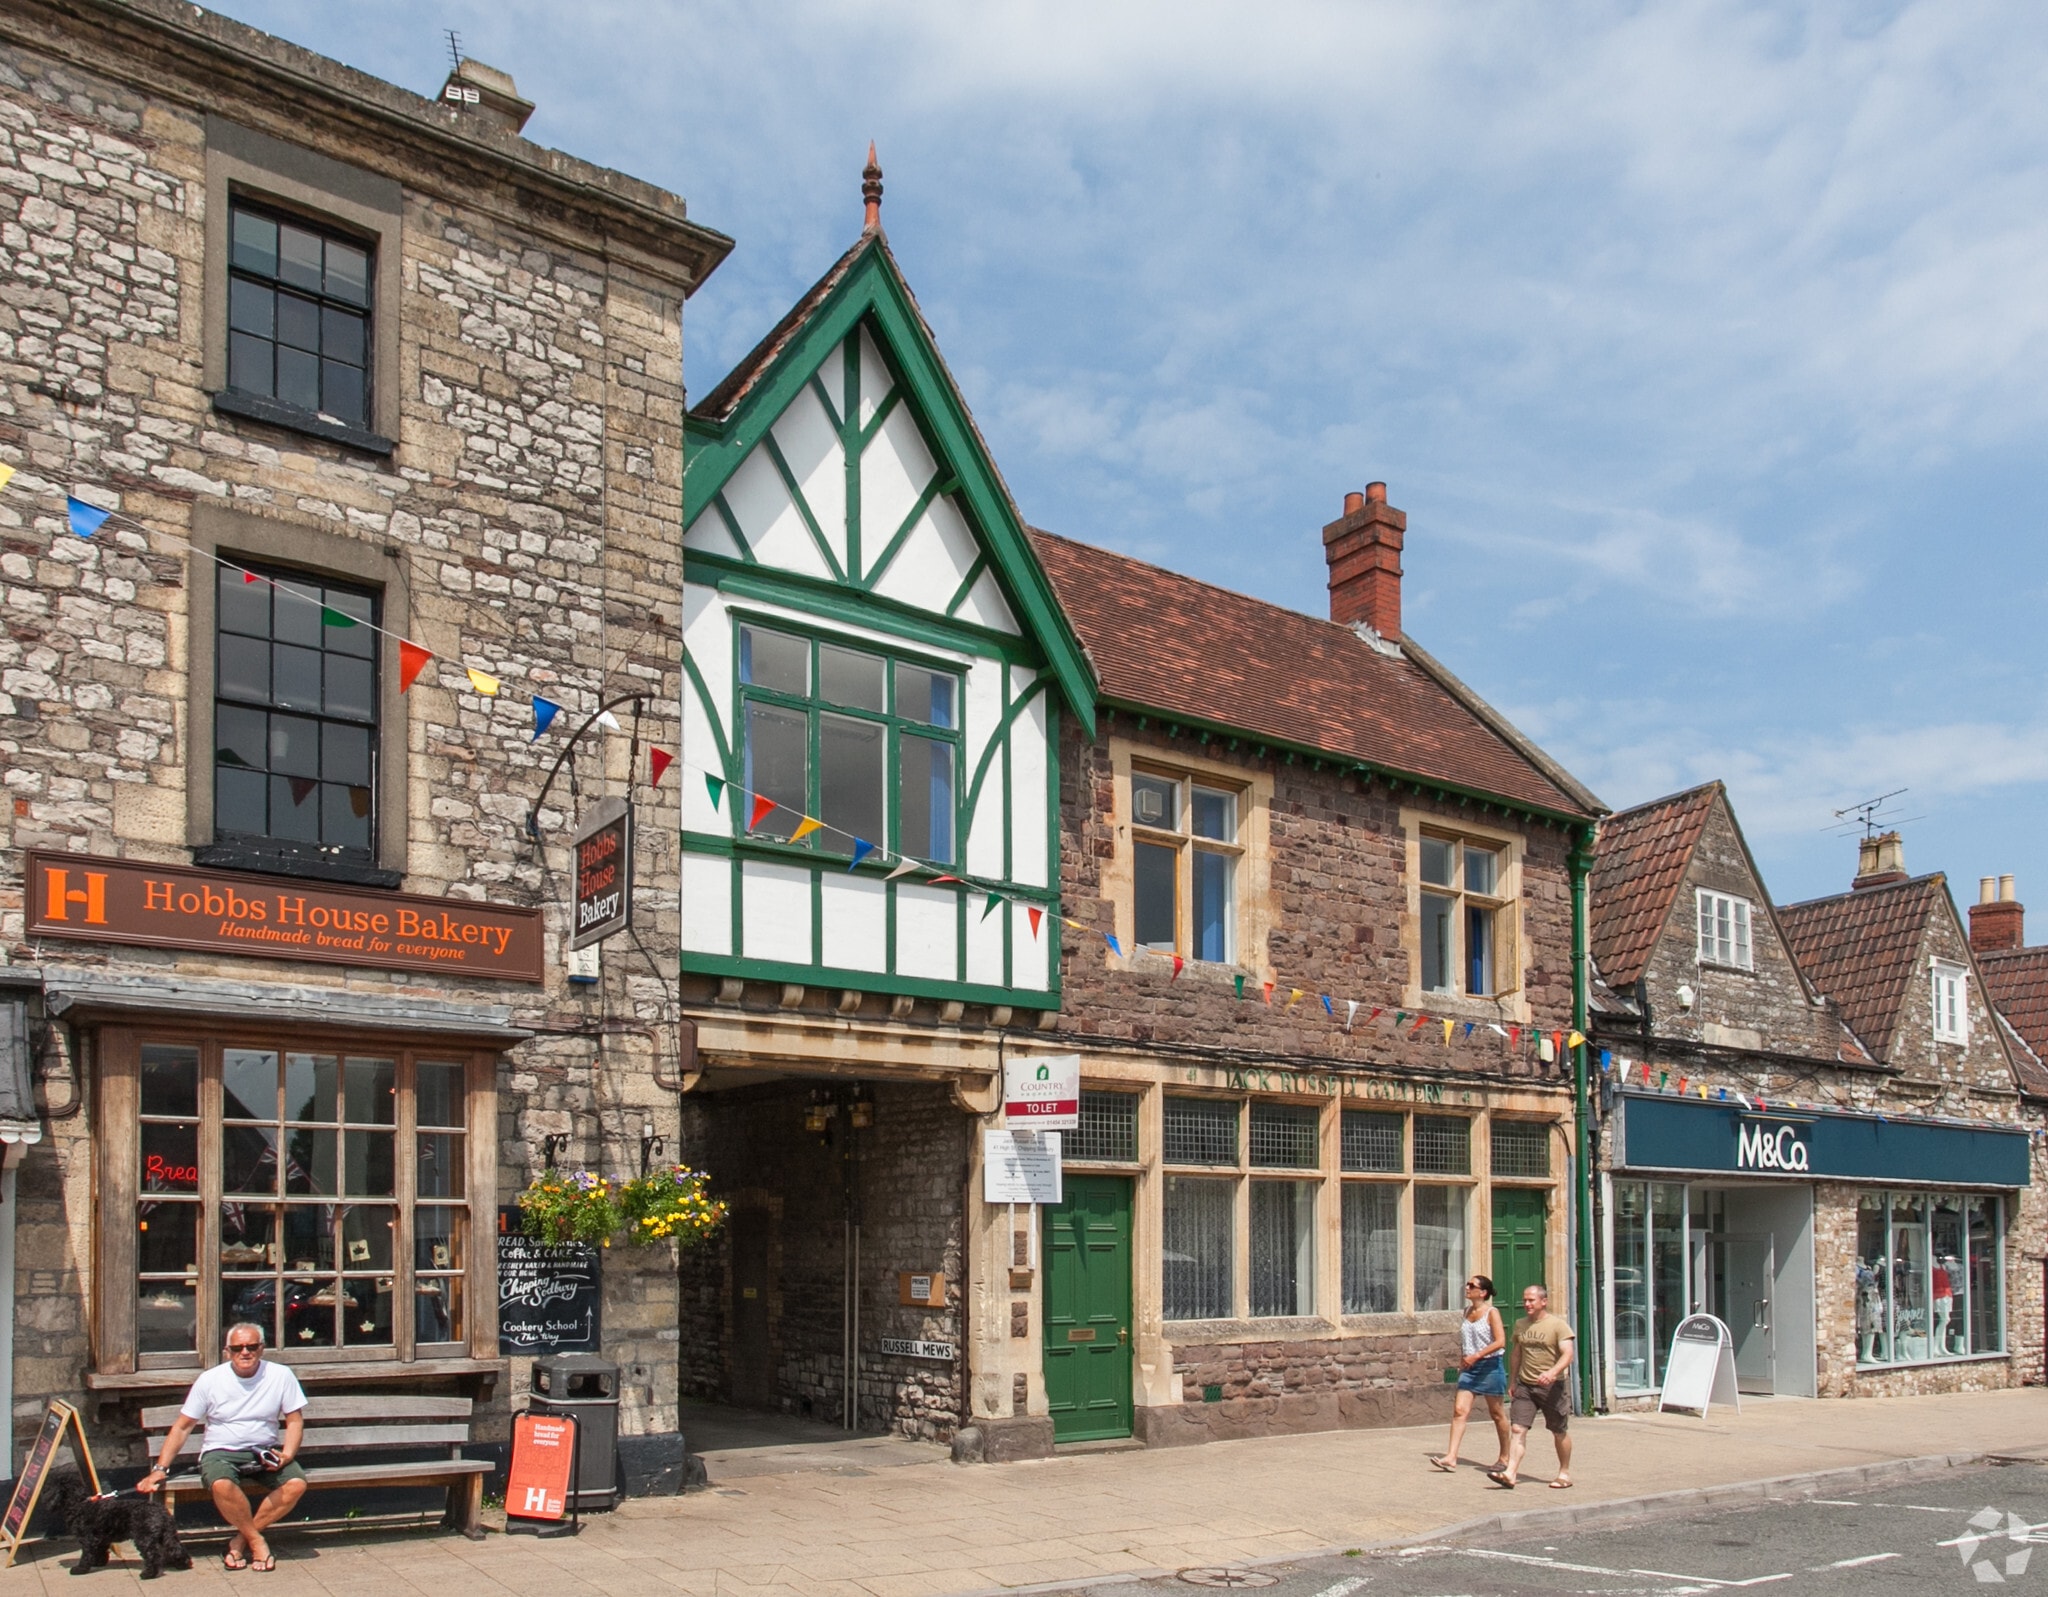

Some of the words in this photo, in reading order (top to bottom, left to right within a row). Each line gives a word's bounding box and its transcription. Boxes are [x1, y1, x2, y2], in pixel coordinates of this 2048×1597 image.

[580, 832, 616, 871] Hobbs
[579, 863, 616, 900] House
[44, 867, 108, 924] H
[143, 880, 267, 921] Hobbs
[278, 895, 389, 935] House
[395, 909, 513, 955] Bakery
[579, 891, 620, 928] Bakery
[218, 920, 311, 945] Handmade
[316, 930, 363, 950] bread
[366, 936, 393, 955] for
[396, 942, 465, 961] everyone
[1020, 1082, 1064, 1091] COUNTRY
[1225, 1067, 1272, 1091] JACK
[1281, 1071, 1360, 1099] RUSSELL
[1366, 1078, 1445, 1104] GALLERY
[1026, 1103, 1039, 1113] TO
[1041, 1103, 1058, 1113] LET
[146, 1155, 198, 1181] Brea
[544, 1248, 573, 1258] CAKE
[500, 1277, 550, 1299] Chipping
[530, 1282, 577, 1306] Sodbury
[503, 1321, 543, 1332] Cookery
[546, 1320, 578, 1330] School
[883, 1340, 919, 1355] RUSSELL
[923, 1343, 951, 1358] MEWS
[535, 1424, 565, 1433] Handmade
[524, 1487, 547, 1512] H
